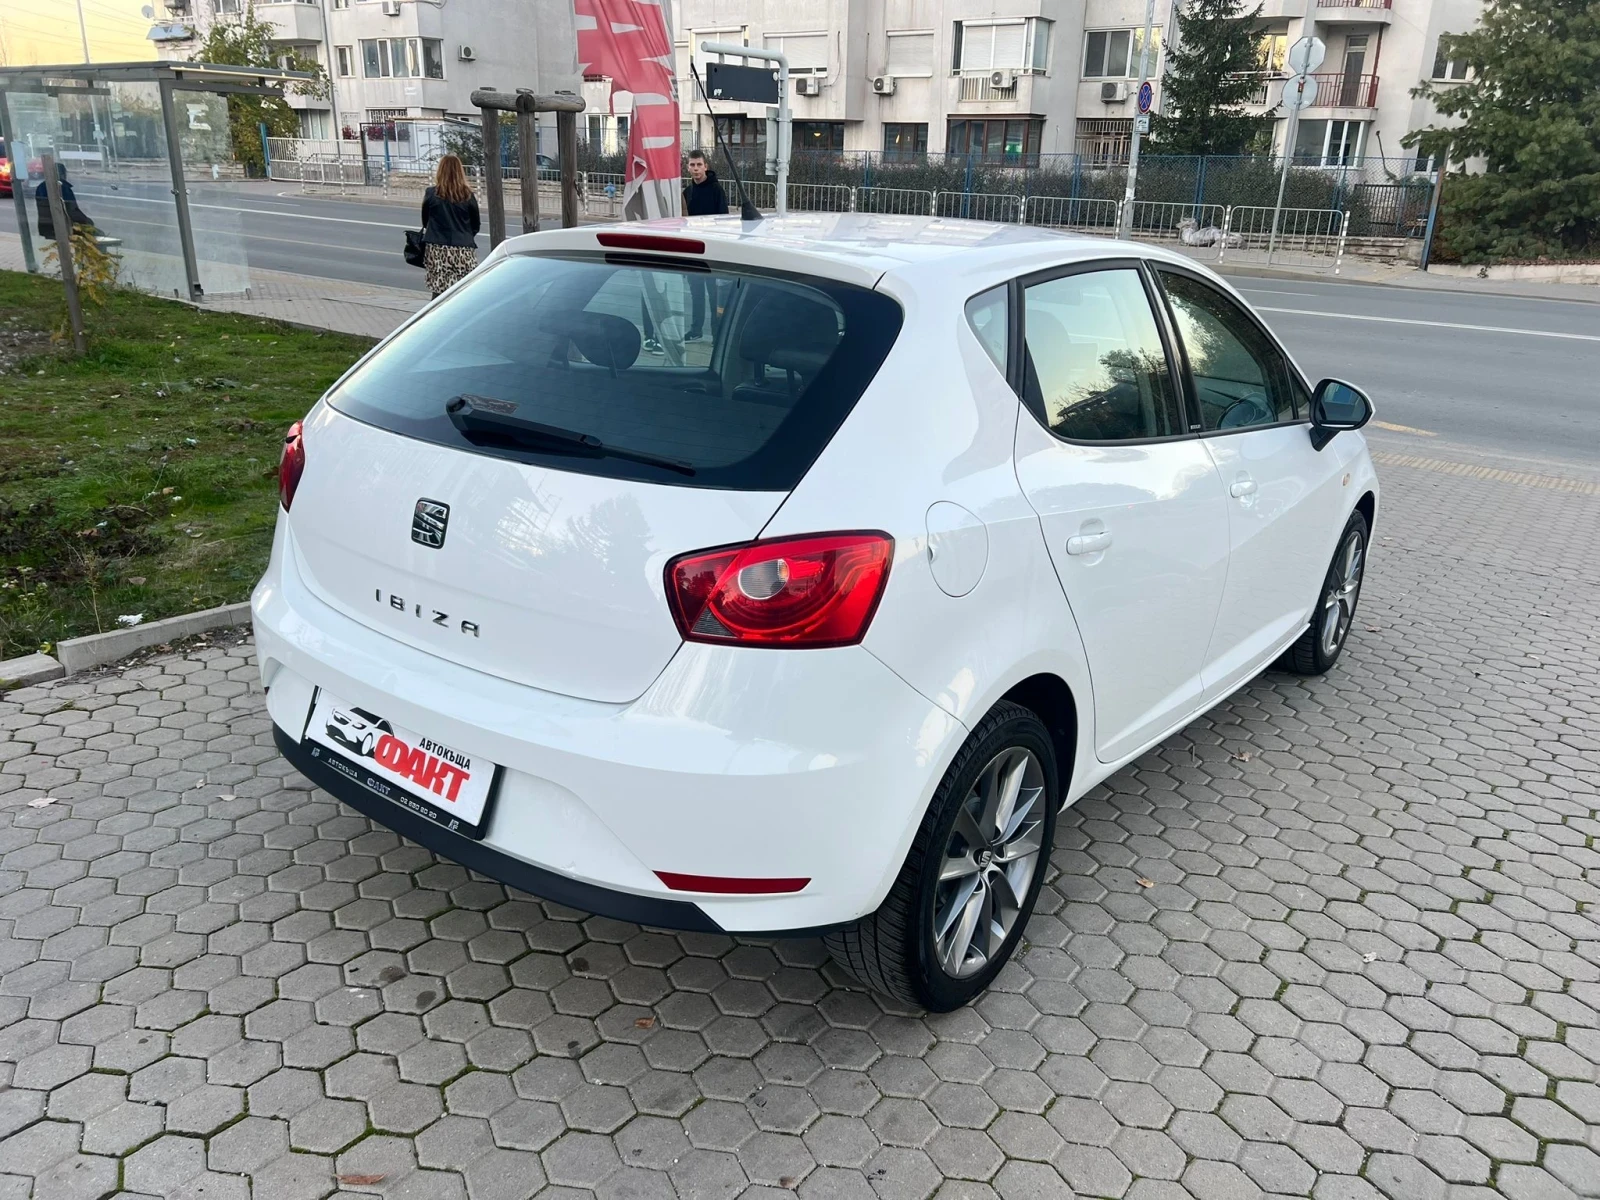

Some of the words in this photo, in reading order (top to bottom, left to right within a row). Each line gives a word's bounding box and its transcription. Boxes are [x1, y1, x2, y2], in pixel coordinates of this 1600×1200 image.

[375, 588, 481, 638] IBIZA
[373, 733, 471, 803] ФАКТ
[419, 737, 471, 770] АВТОКЪЩА
[366, 777, 391, 795] ФАКТ
